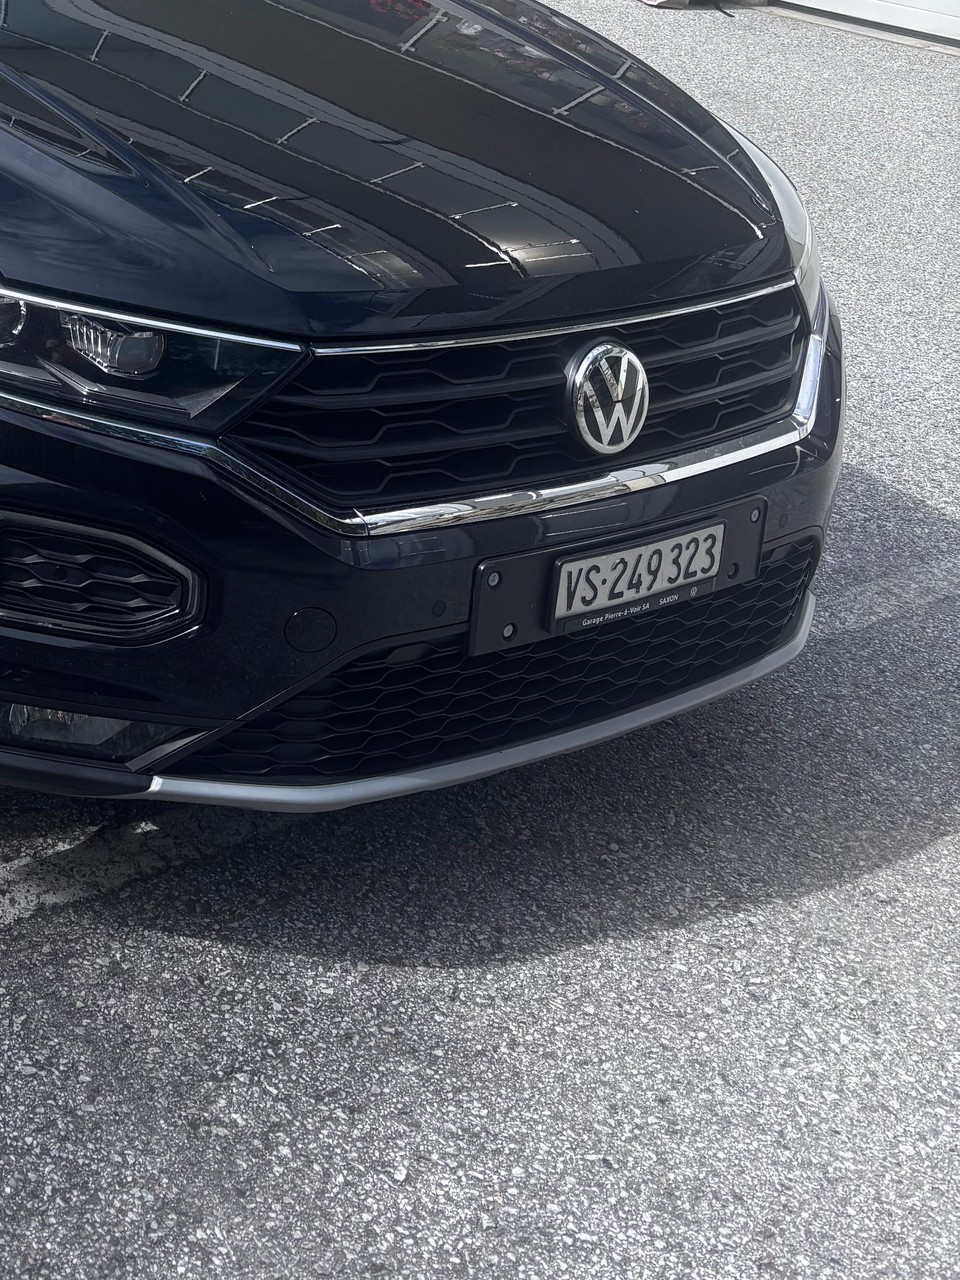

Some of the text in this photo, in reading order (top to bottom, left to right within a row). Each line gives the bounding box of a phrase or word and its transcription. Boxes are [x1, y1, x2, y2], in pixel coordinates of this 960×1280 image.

[579, 349, 646, 450] VW
[582, 614, 604, 626] Garage
[604, 605, 642, 621] Pierre-à-Voir
[642, 602, 650, 611] SA
[659, 594, 679, 606] SAXON
